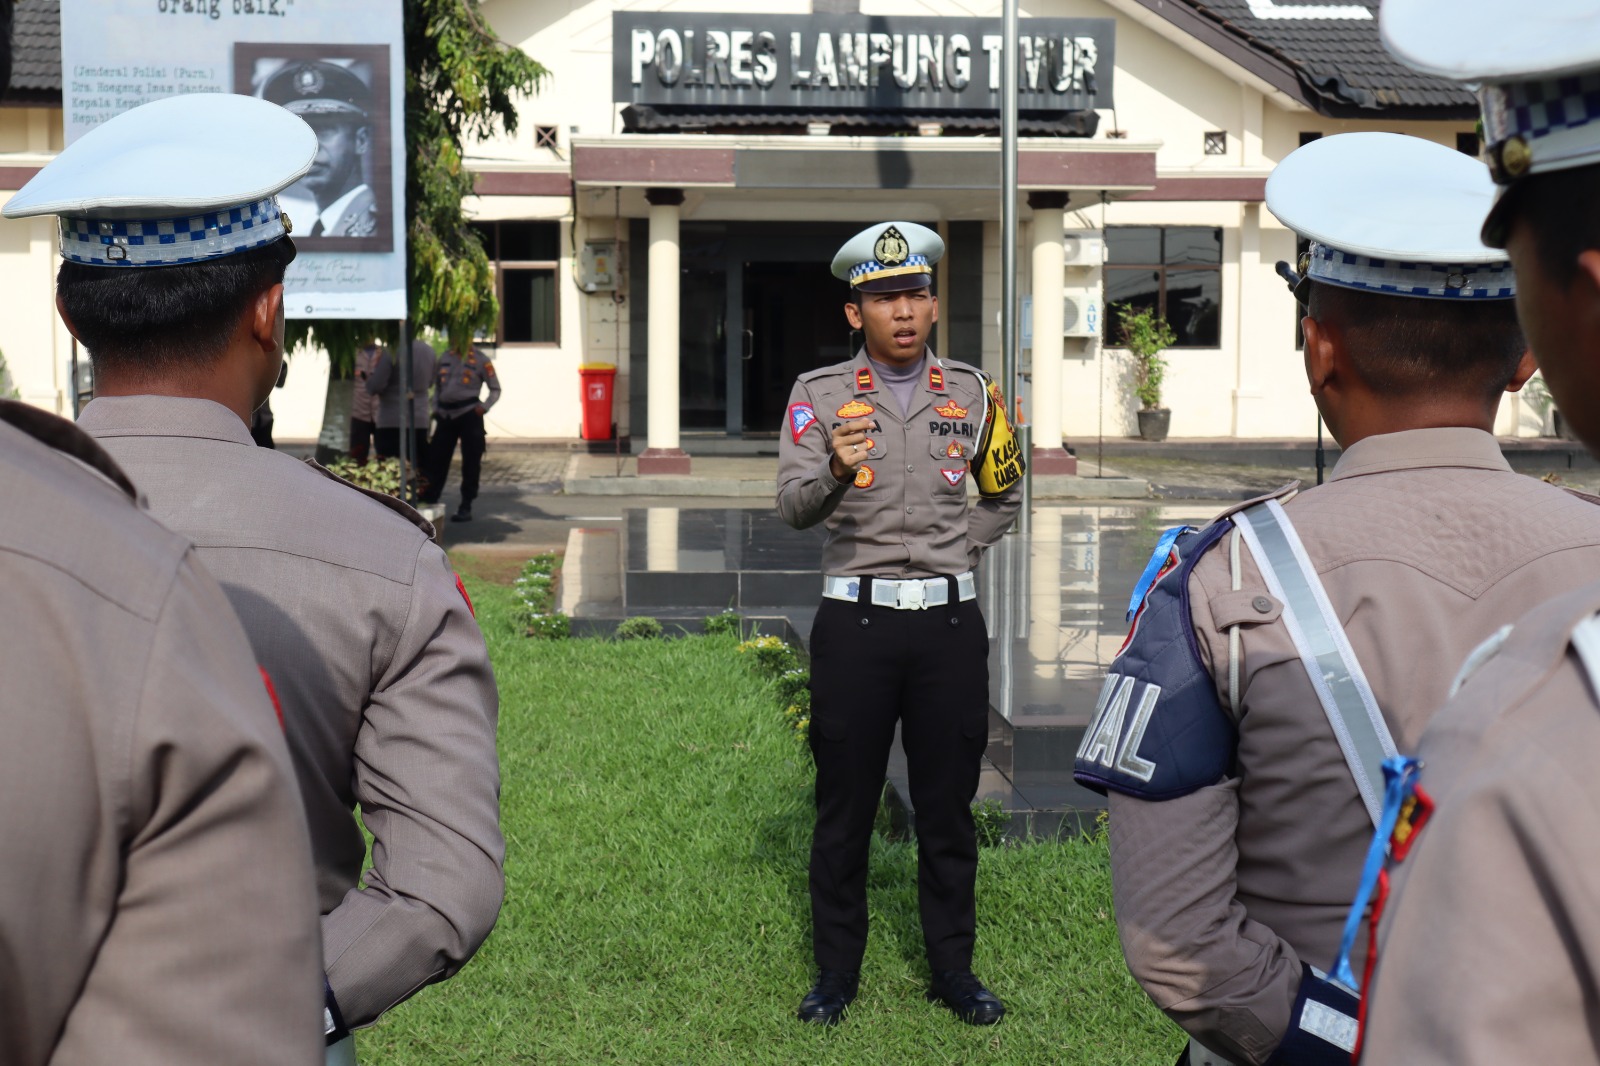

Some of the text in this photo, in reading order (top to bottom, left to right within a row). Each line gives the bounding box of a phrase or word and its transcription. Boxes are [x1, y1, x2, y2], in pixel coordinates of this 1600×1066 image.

[631, 28, 1098, 94] POLRES LAMPUNG TMUR
[1087, 304, 1096, 333] AUX
[929, 421, 973, 437] POLRI
